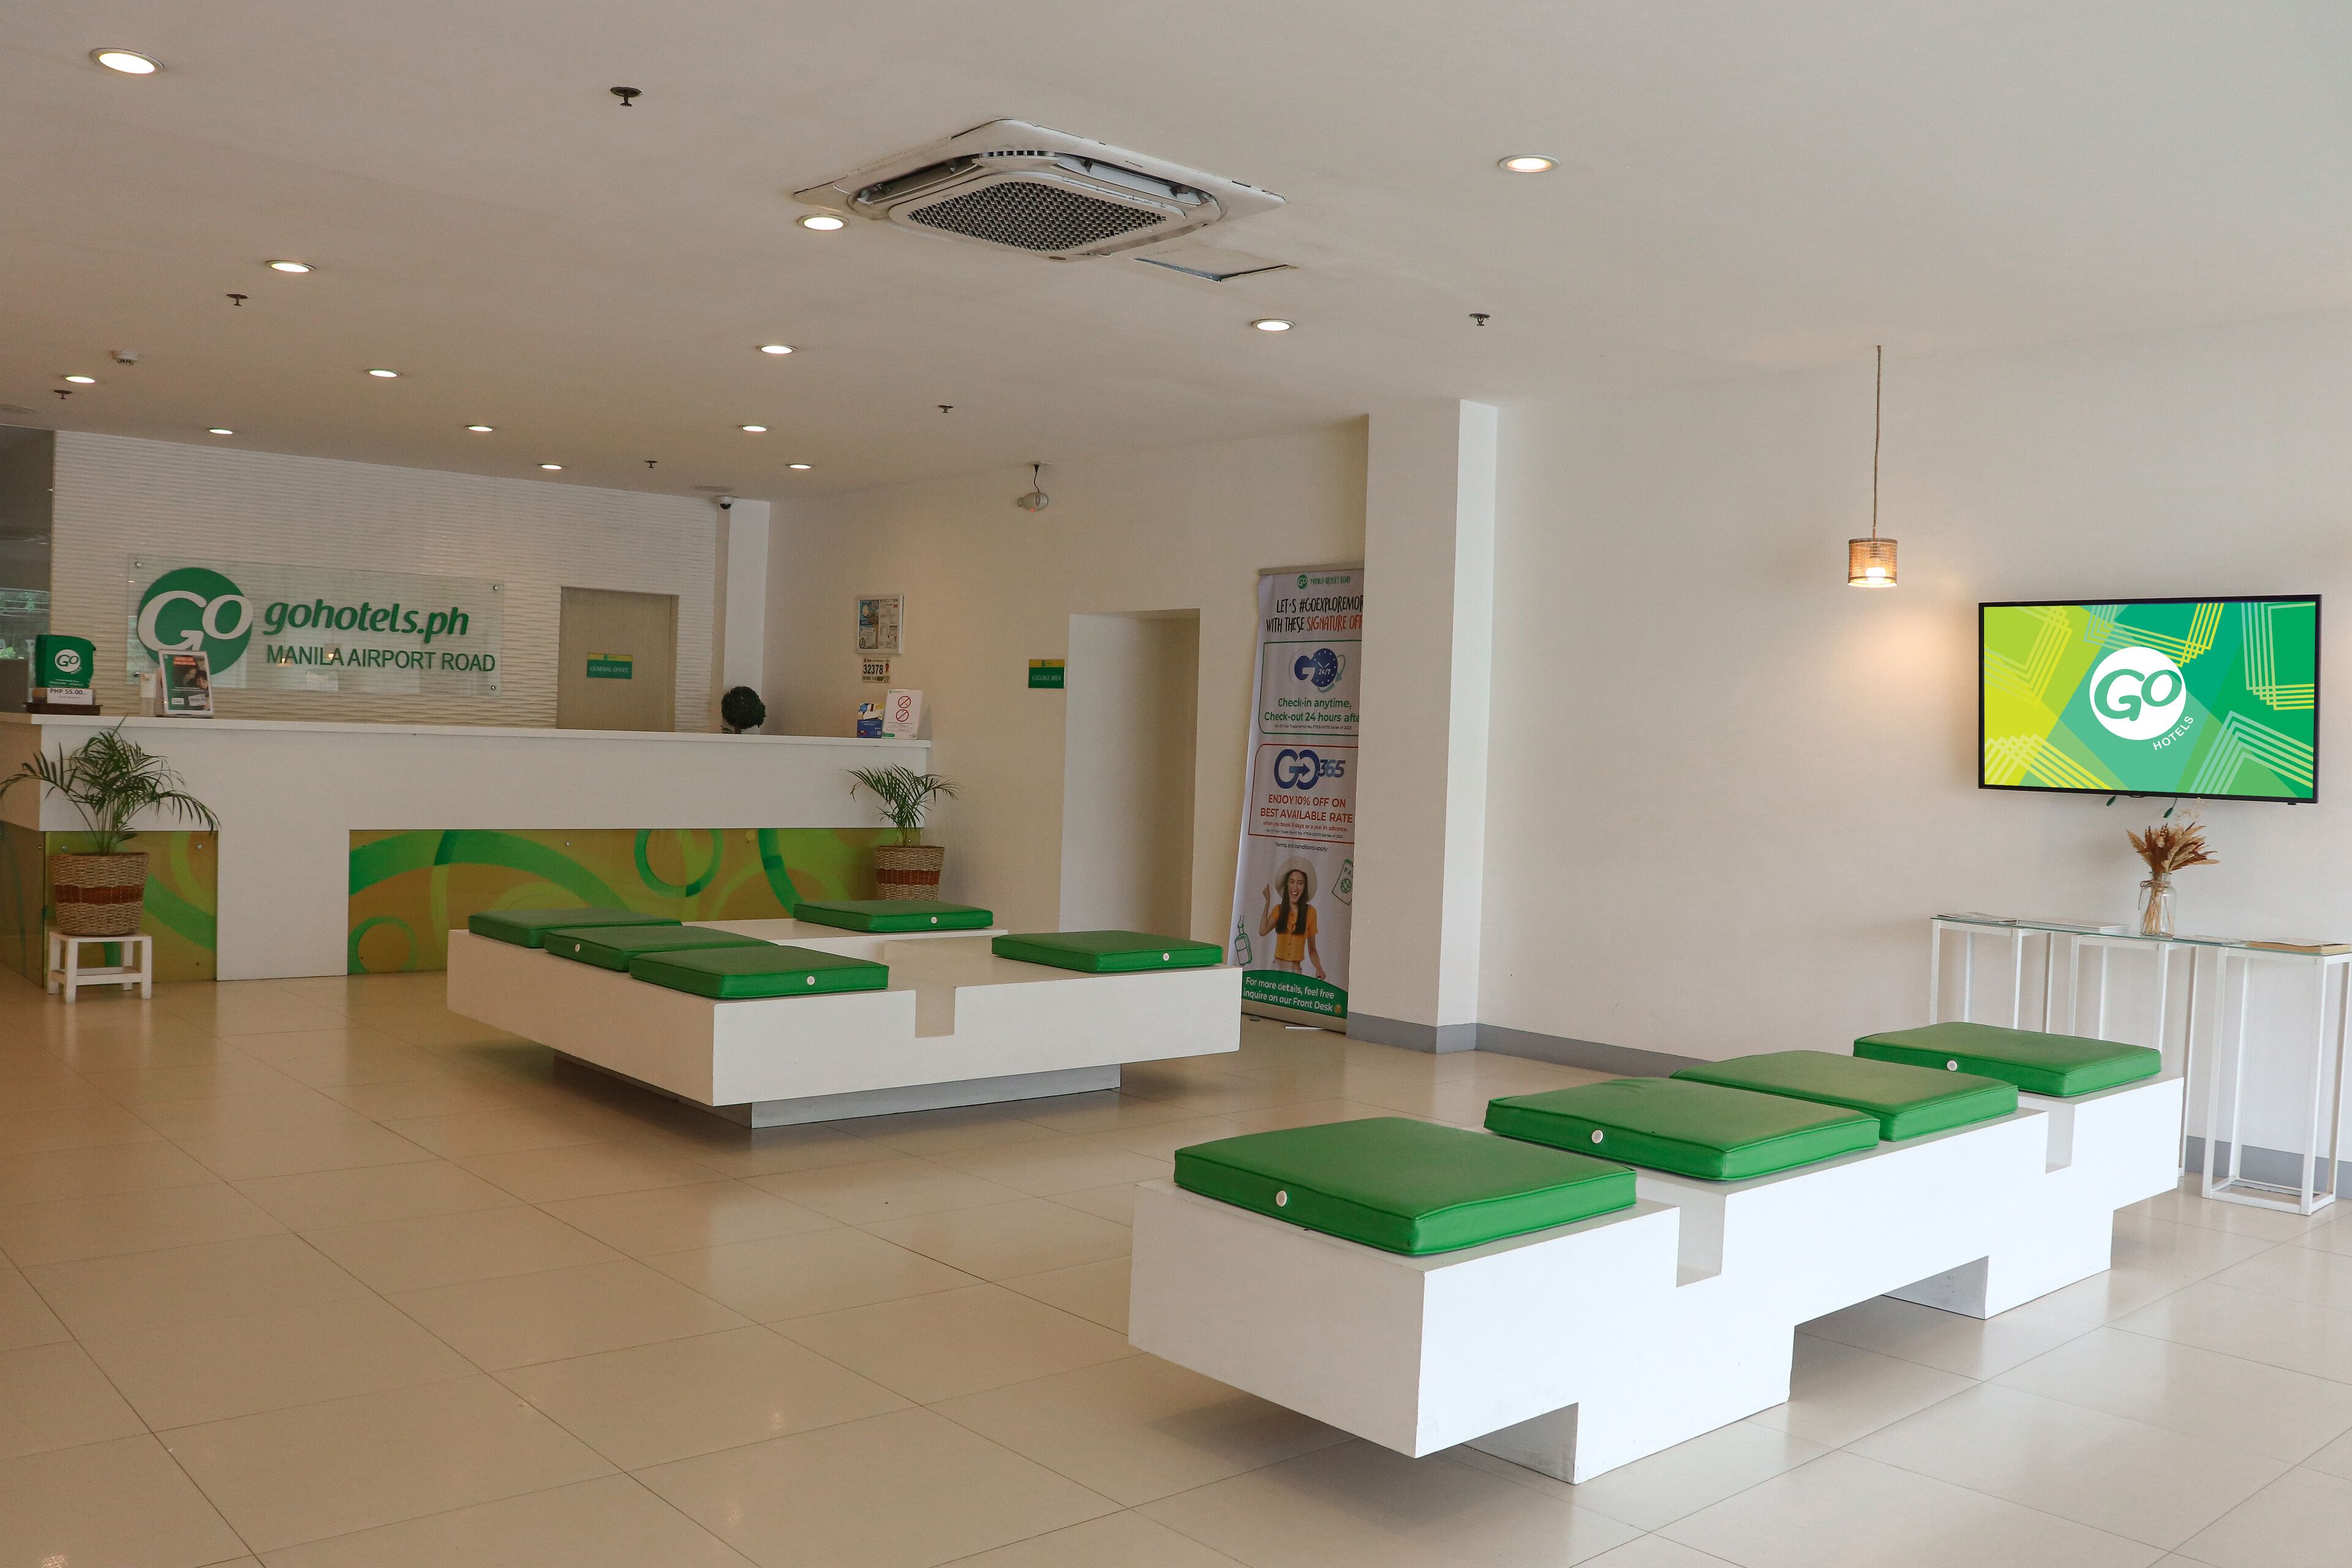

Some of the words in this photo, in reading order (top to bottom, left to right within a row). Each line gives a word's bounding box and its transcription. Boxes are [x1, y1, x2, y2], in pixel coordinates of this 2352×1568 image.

[1276, 598, 1297, 614] LET'S
[1299, 595, 1363, 613] #GOEXPLOREMOR
[138, 590, 254, 652] GO
[262, 598, 469, 644] gohotels.ph
[1266, 617, 1283, 633] WITH
[1285, 617, 1305, 633] THESE
[1306, 615, 1348, 632] SIGNATURE
[1349, 614, 1363, 630] OFF
[56, 654, 79, 666] GO
[266, 644, 344, 666] MANILA
[347, 648, 436, 669] AIRPORT
[442, 652, 496, 672] ROAD
[864, 664, 883, 674] 32378
[1278, 698, 1312, 707] Check-in
[1314, 698, 1351, 709] anytime,
[2094, 668, 2182, 722] GO
[1264, 712, 1303, 721] Check-out
[1305, 712, 1316, 721] 24
[1318, 712, 1341, 722] hours
[1344, 713, 1360, 722] afte
[2152, 715, 2194, 752] HOTELS
[1268, 794, 1294, 804] ENJOY
[1295, 796, 1311, 805] 10%
[1313, 797, 1329, 807] OFF
[1332, 798, 1346, 808] ON
[1261, 808, 1279, 817] BEST
[1280, 809, 1327, 821] AVAILABLE
[1329, 812, 1353, 823] RATE
[1258, 980, 1276, 989] more
[1278, 982, 1303, 995] details,
[1305, 986, 1318, 996] feel
[1319, 989, 1334, 999] free
[1243, 988, 1267, 1000] inquire
[1293, 997, 1313, 1008] Front
[1314, 1001, 1333, 1012] Desk
